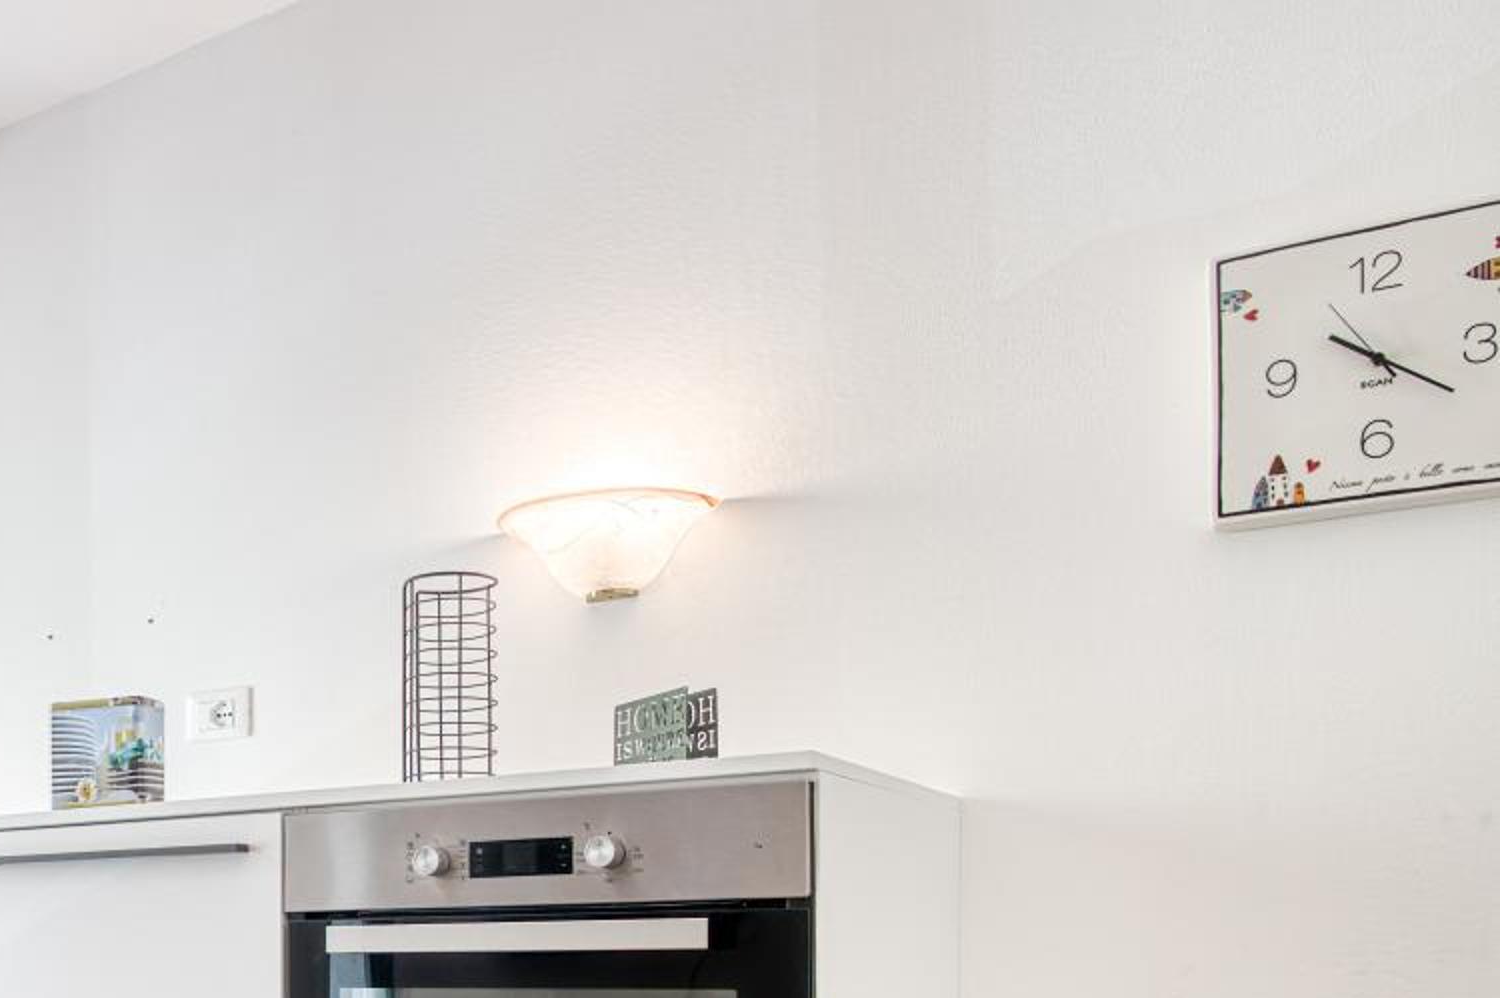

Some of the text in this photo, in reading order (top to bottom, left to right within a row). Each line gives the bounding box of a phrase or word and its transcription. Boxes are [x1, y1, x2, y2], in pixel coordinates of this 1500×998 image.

[1348, 249, 1404, 294] 12
[1462, 321, 1499, 364] 3
[1265, 358, 1298, 398] 9
[1360, 418, 1395, 459] 6
